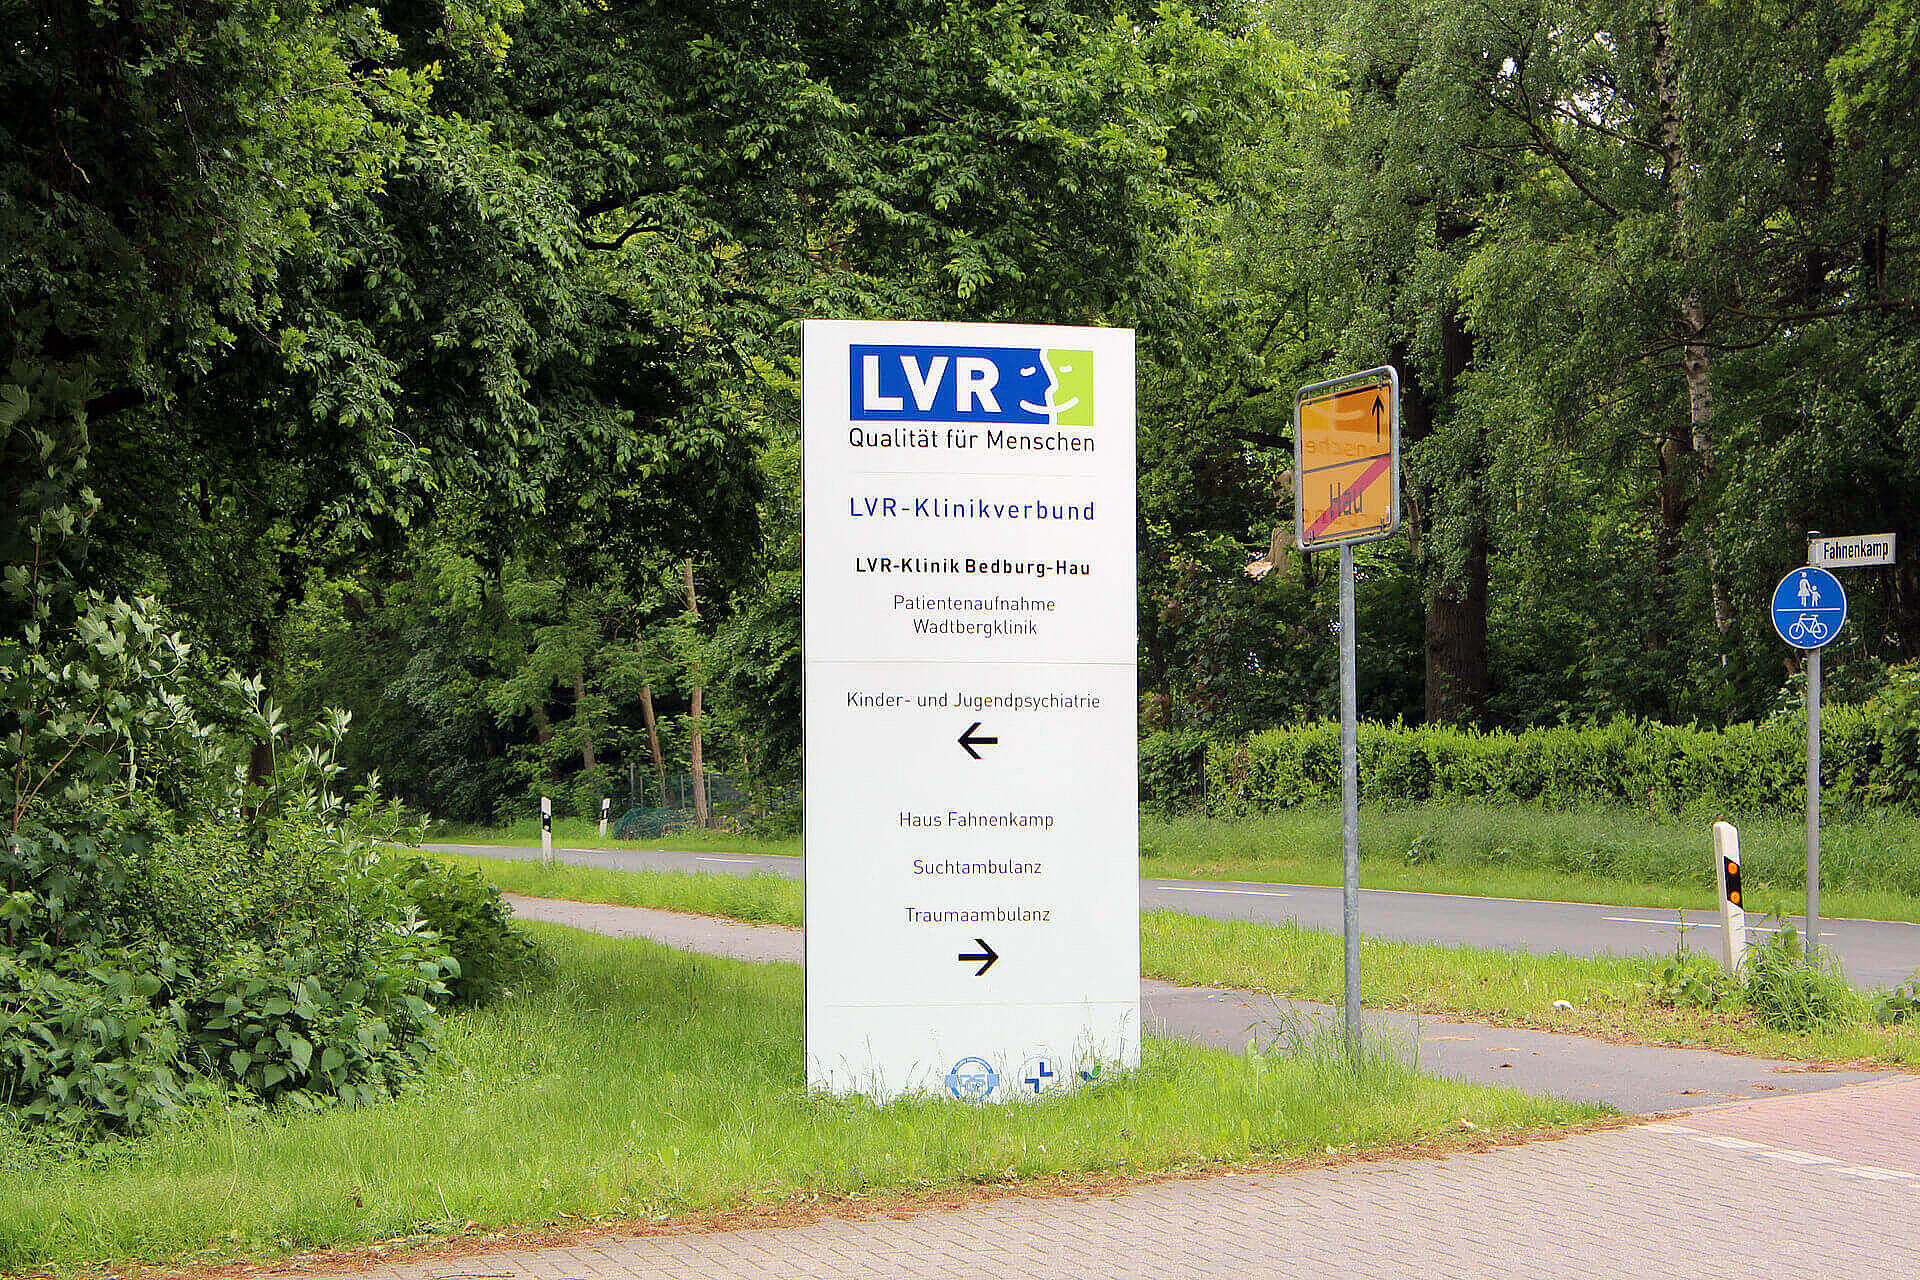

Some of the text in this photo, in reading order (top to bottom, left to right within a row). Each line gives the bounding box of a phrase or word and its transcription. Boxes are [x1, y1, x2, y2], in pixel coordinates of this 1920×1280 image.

[863, 354, 1001, 413] LVR
[849, 428, 1095, 452] Qualität für Menschen
[850, 498, 1095, 520] LVR-Klinikverbund
[1329, 482, 1363, 518] Hau
[1823, 540, 1889, 560] Fahnenkamp
[856, 557, 1090, 577] LVR-Klinik Bedburg-Hau
[894, 595, 1056, 611] Patientenaufnahme
[847, 692, 1100, 711] Kinder- und Jugendpsychiatrie
[900, 812, 1054, 830] Haus Fahnenkamp
[913, 859, 1042, 875] Suchtambulanz
[905, 907, 1050, 922] Traumaambulanz
